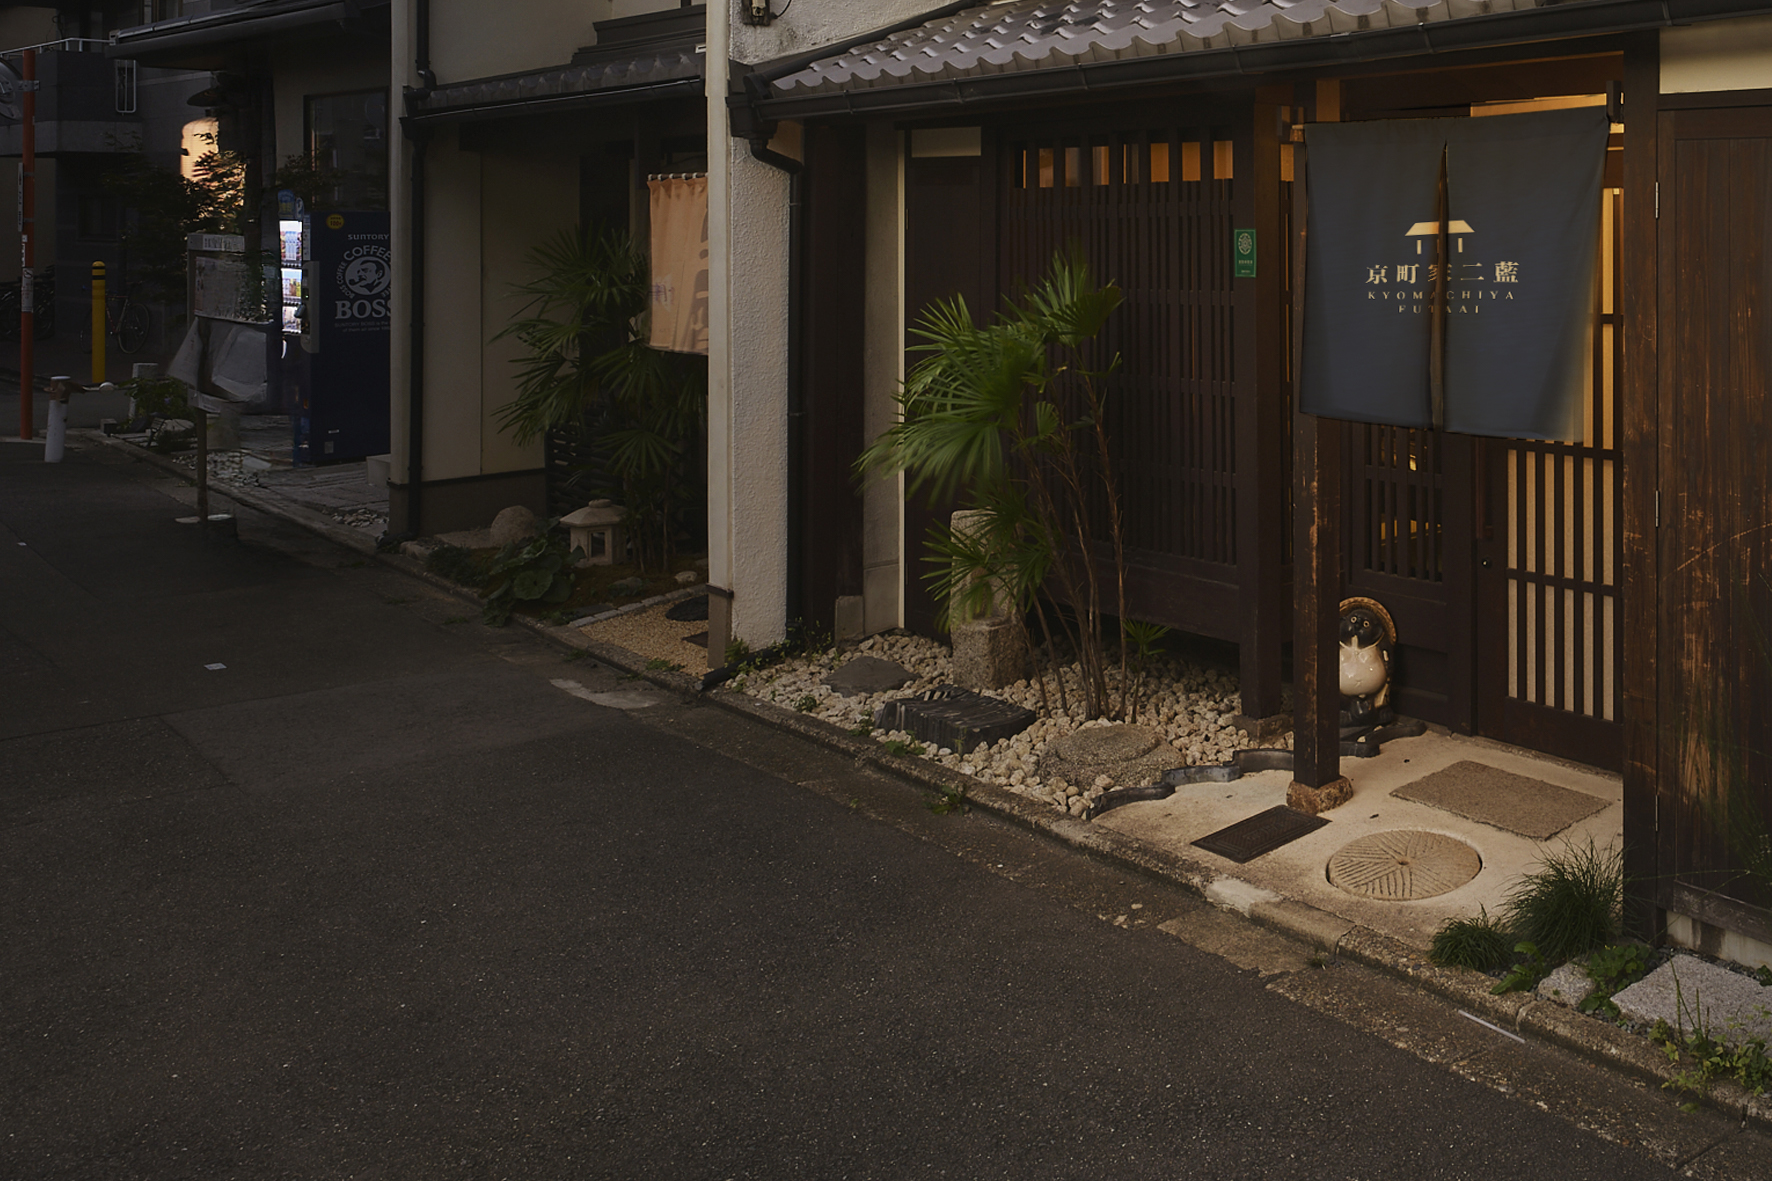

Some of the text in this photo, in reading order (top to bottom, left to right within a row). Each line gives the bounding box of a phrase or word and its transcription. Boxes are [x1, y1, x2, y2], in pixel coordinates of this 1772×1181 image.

[347, 233, 390, 241] SUNTORY
[1367, 290, 1514, 300] KYOMACHIYA
[1398, 304, 1480, 314] FUTAAI
